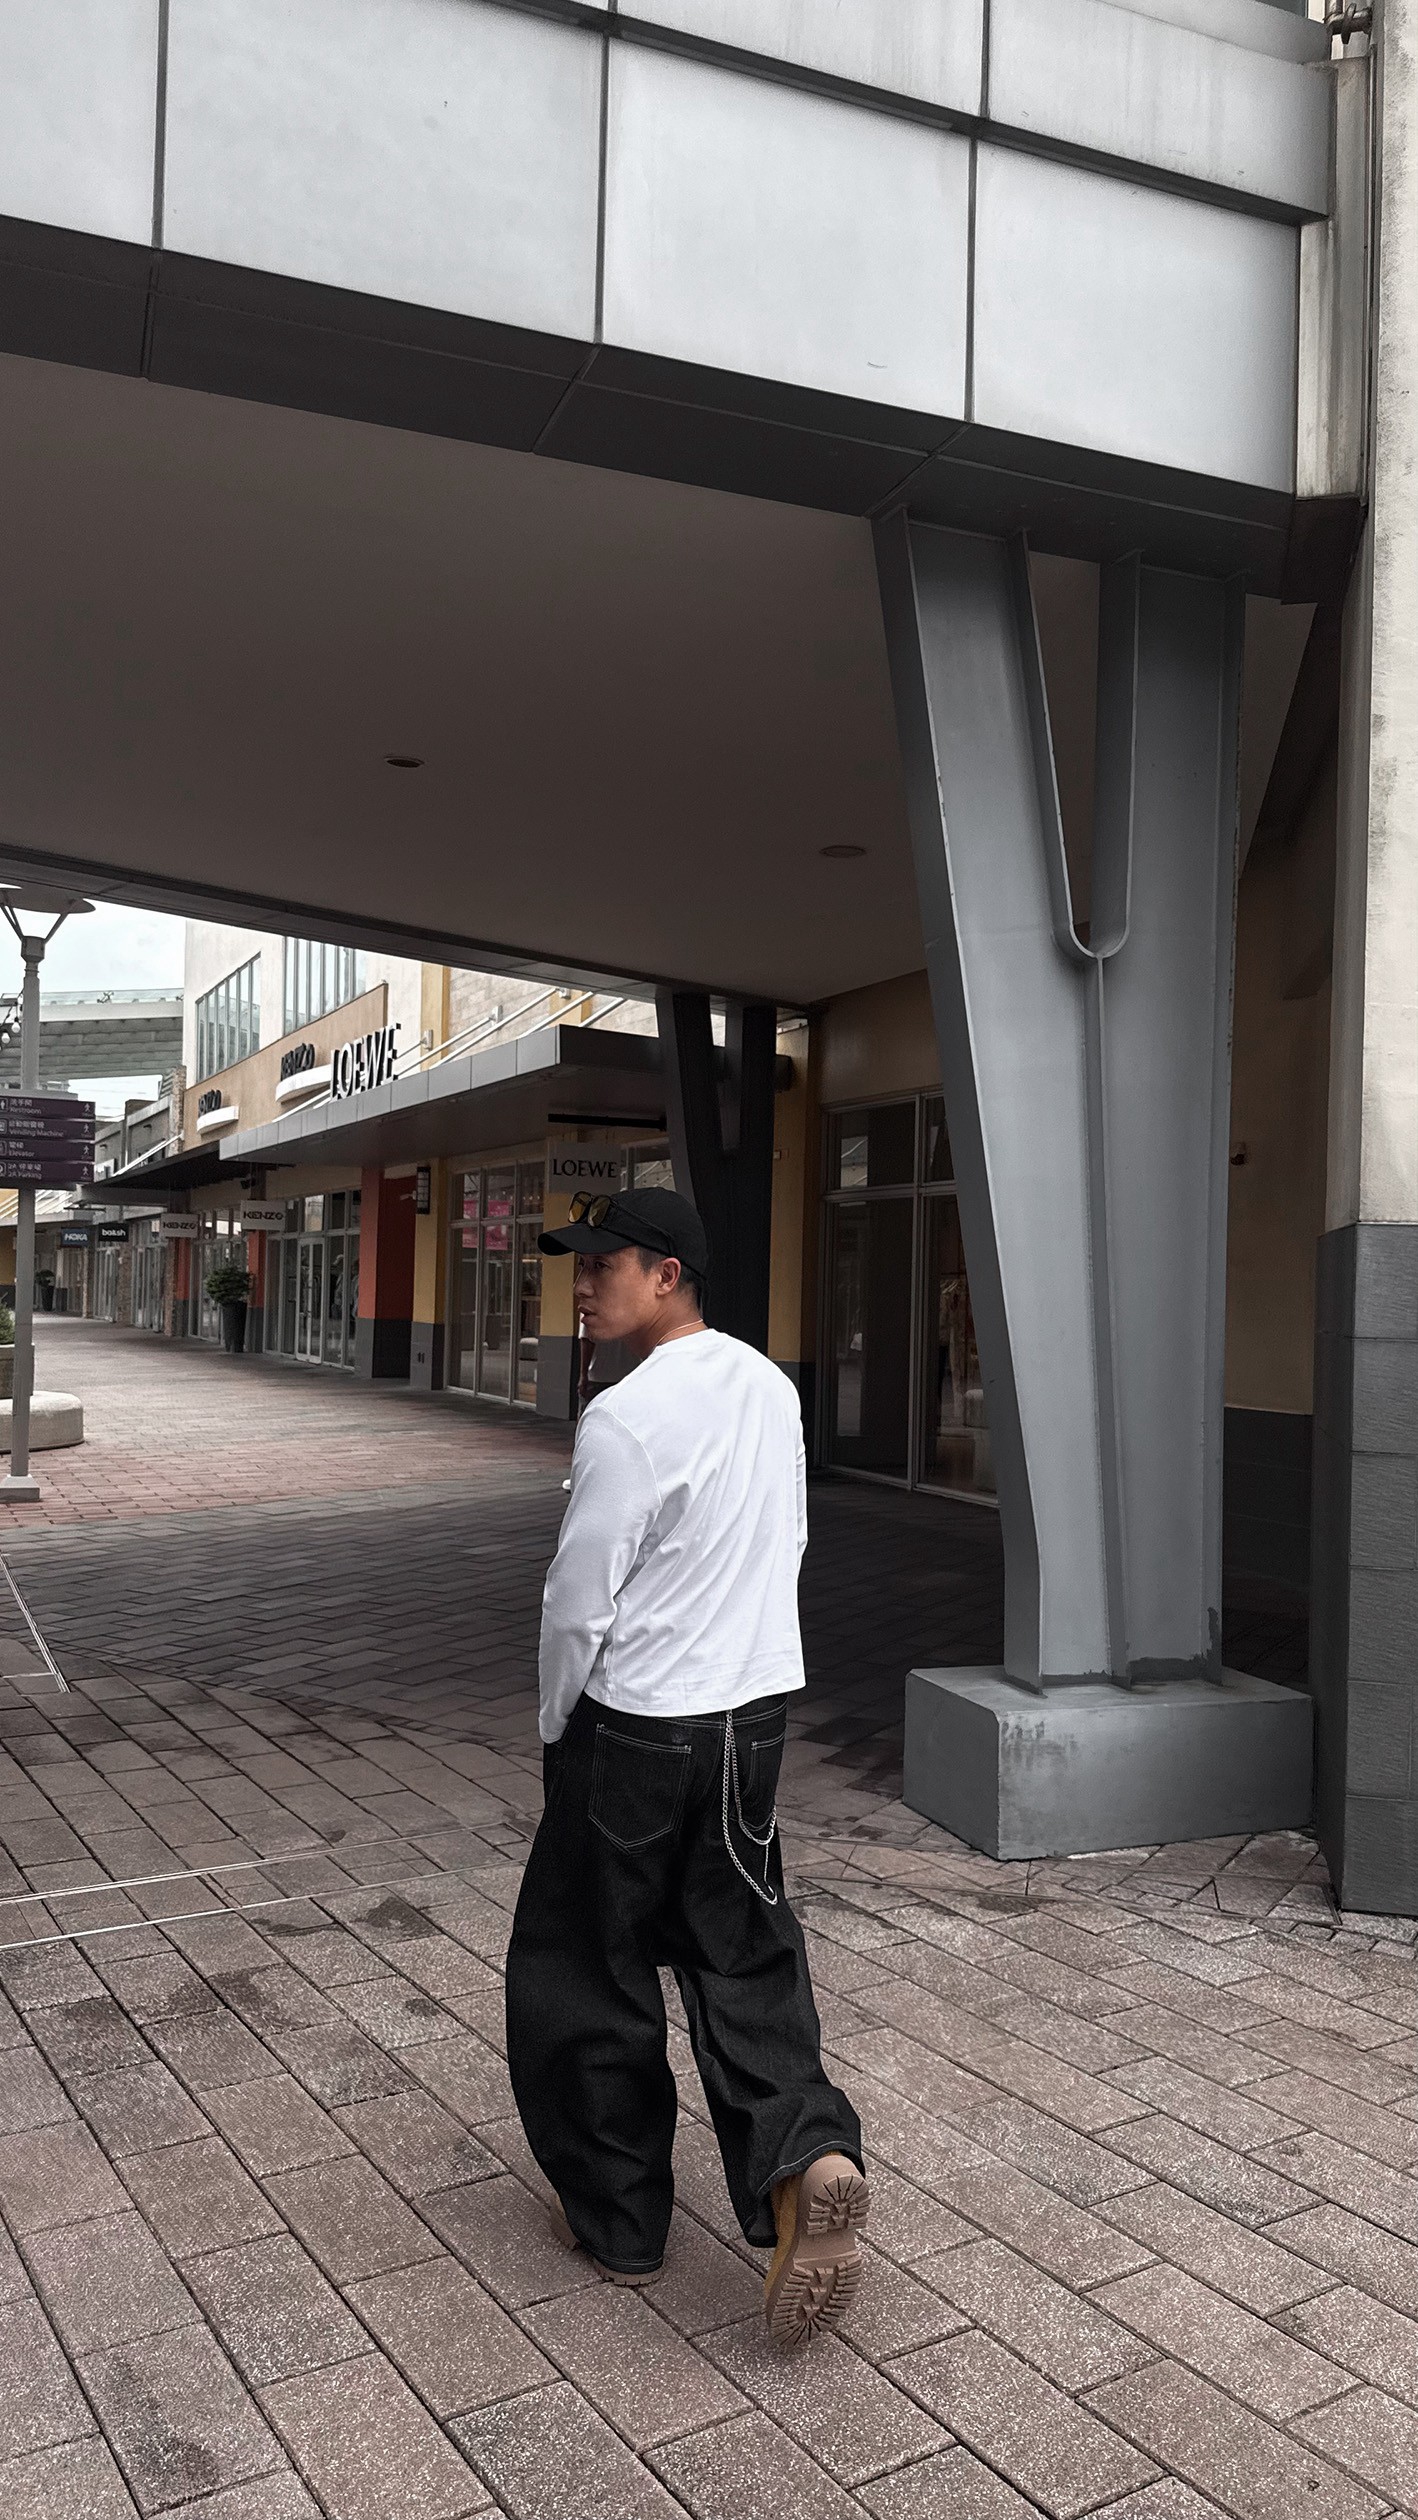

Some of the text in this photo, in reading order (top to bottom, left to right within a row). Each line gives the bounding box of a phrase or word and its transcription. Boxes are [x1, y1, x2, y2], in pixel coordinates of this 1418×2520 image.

[330, 1022, 402, 1102] LOEWE
[9, 1107, 42, 1115] Restroom
[9, 1129, 64, 1138] Vending Machine
[552, 1158, 618, 1178] LOEWE
[18, 1171, 42, 1180] Parking
[243, 1211, 284, 1221] KENZO
[163, 1221, 196, 1230] KENZO
[64, 1233, 88, 1242] HOKA
